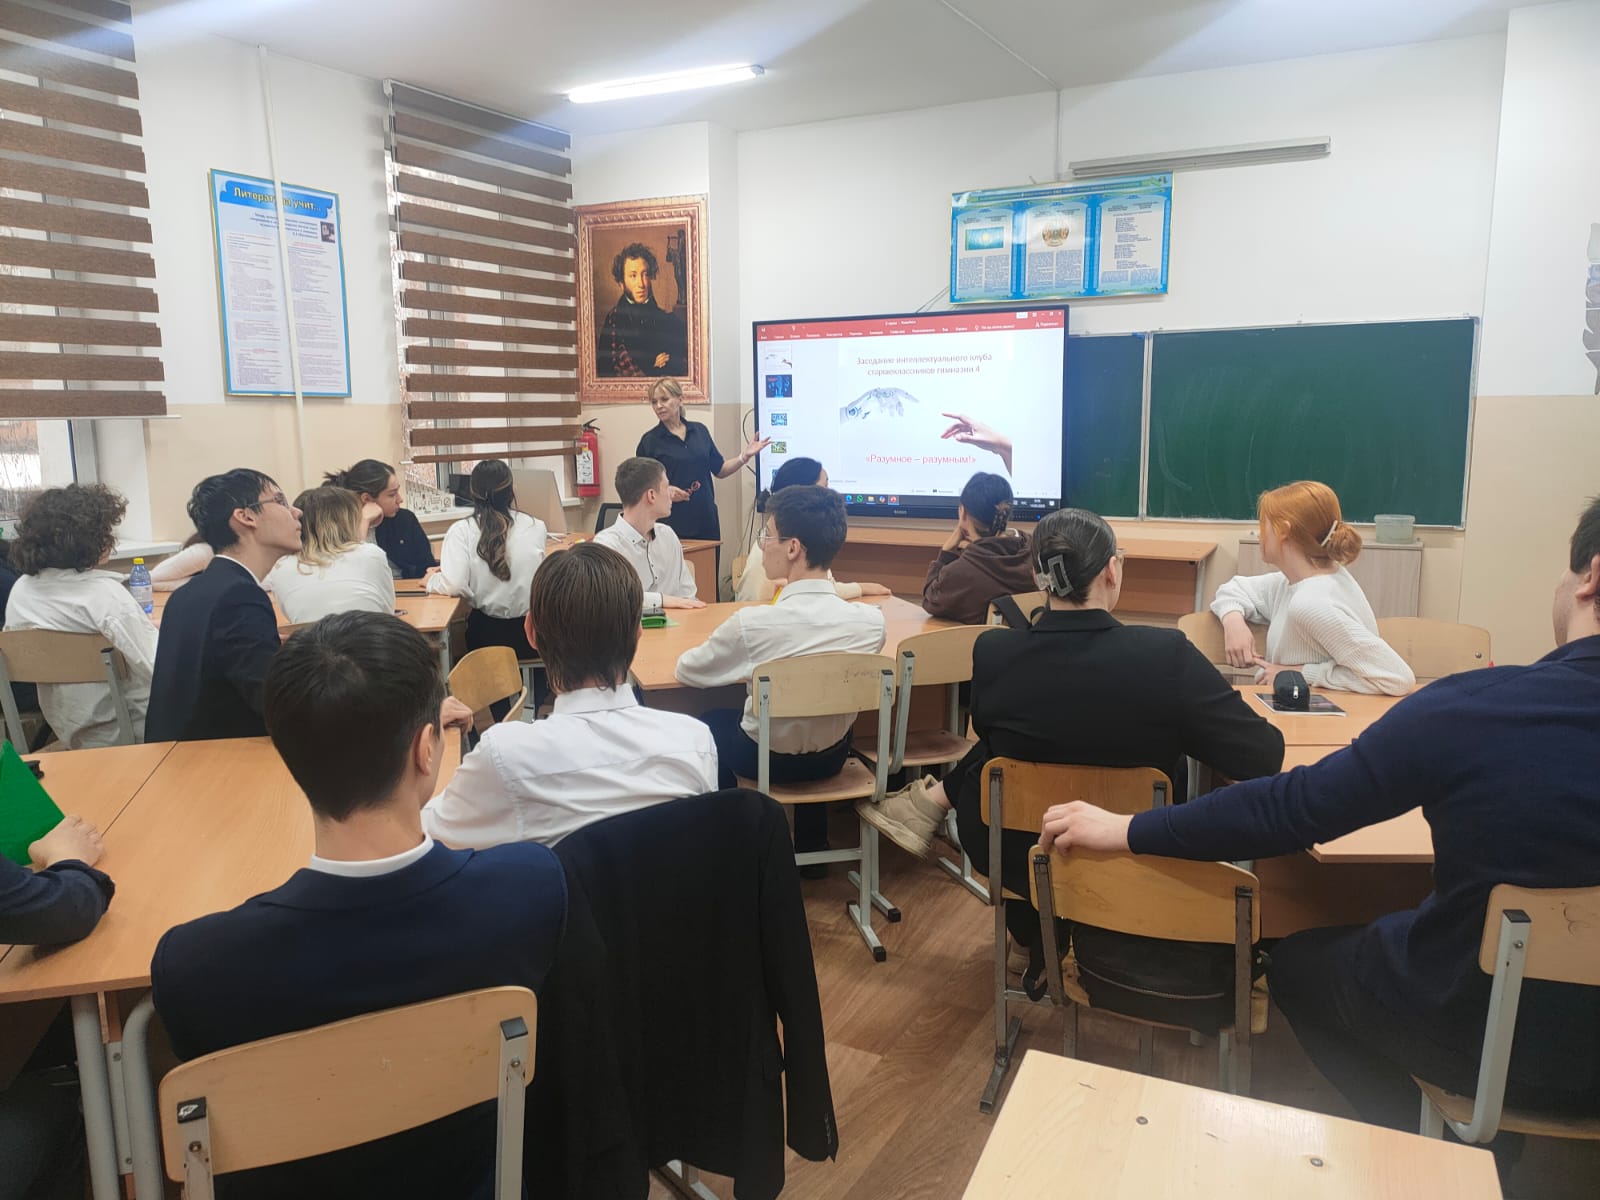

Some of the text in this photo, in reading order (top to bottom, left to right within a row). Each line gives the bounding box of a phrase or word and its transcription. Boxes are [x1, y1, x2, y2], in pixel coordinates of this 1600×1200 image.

[233, 186, 291, 206] Литерата
[857, 352, 993, 366] Заседание интеллектуального клуба
[936, 366, 973, 375] гимназии
[865, 454, 912, 465] «Разумное
[922, 455, 977, 465] разумным!»
